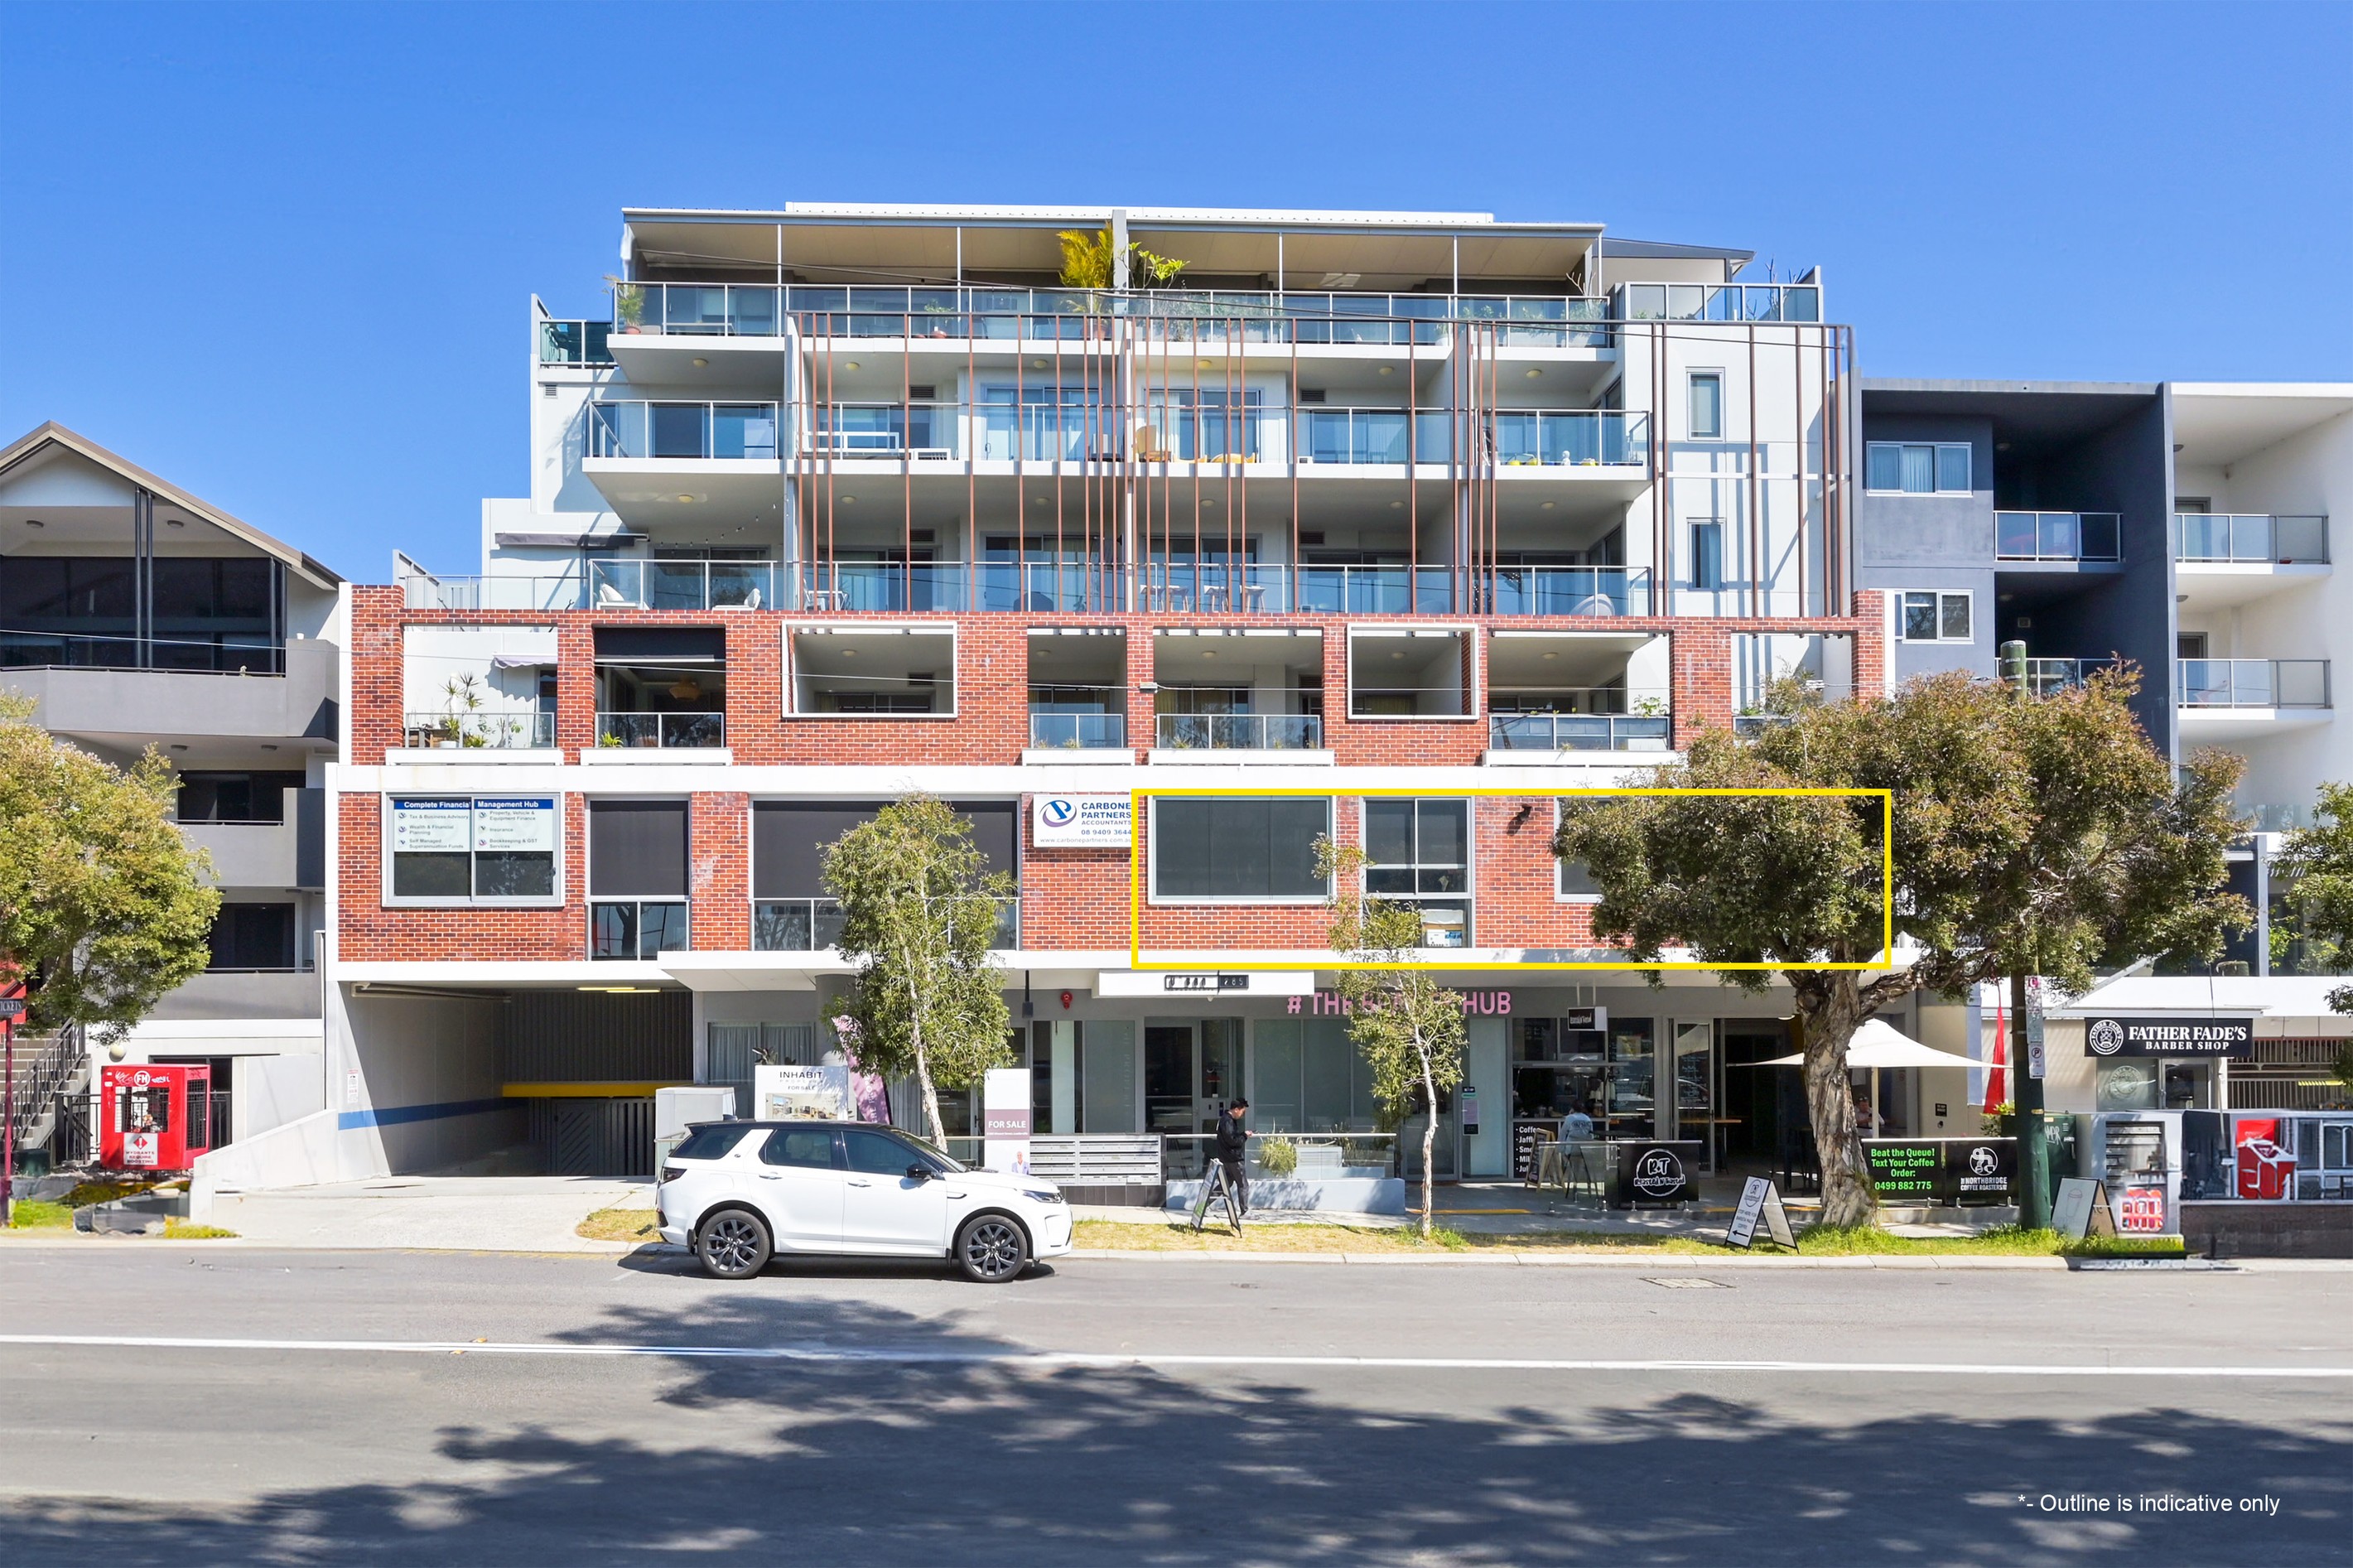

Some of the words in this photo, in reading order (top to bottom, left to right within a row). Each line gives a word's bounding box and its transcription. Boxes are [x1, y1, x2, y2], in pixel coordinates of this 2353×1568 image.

[0, 1001, 22, 1011] ICKETS
[1463, 991, 1512, 1015] HUB
[2129, 1026, 2191, 1040] FATHER
[2192, 1025, 2247, 1041] FADE'S
[2145, 1041, 2193, 1050] BARBER
[2197, 1041, 2230, 1050] SHOP
[1871, 1148, 1890, 1157] Beat
[1891, 1148, 1905, 1157] the
[1906, 1148, 1935, 1158] Queue!
[1871, 1158, 1888, 1167] Text
[1888, 1159, 1907, 1167] Your
[1907, 1158, 1935, 1167] Coffee
[1890, 1168, 1916, 1177] Order:
[1874, 1181, 1896, 1190] 0499
[1897, 1181, 1914, 1190] 882
[1916, 1181, 1932, 1189] 775
